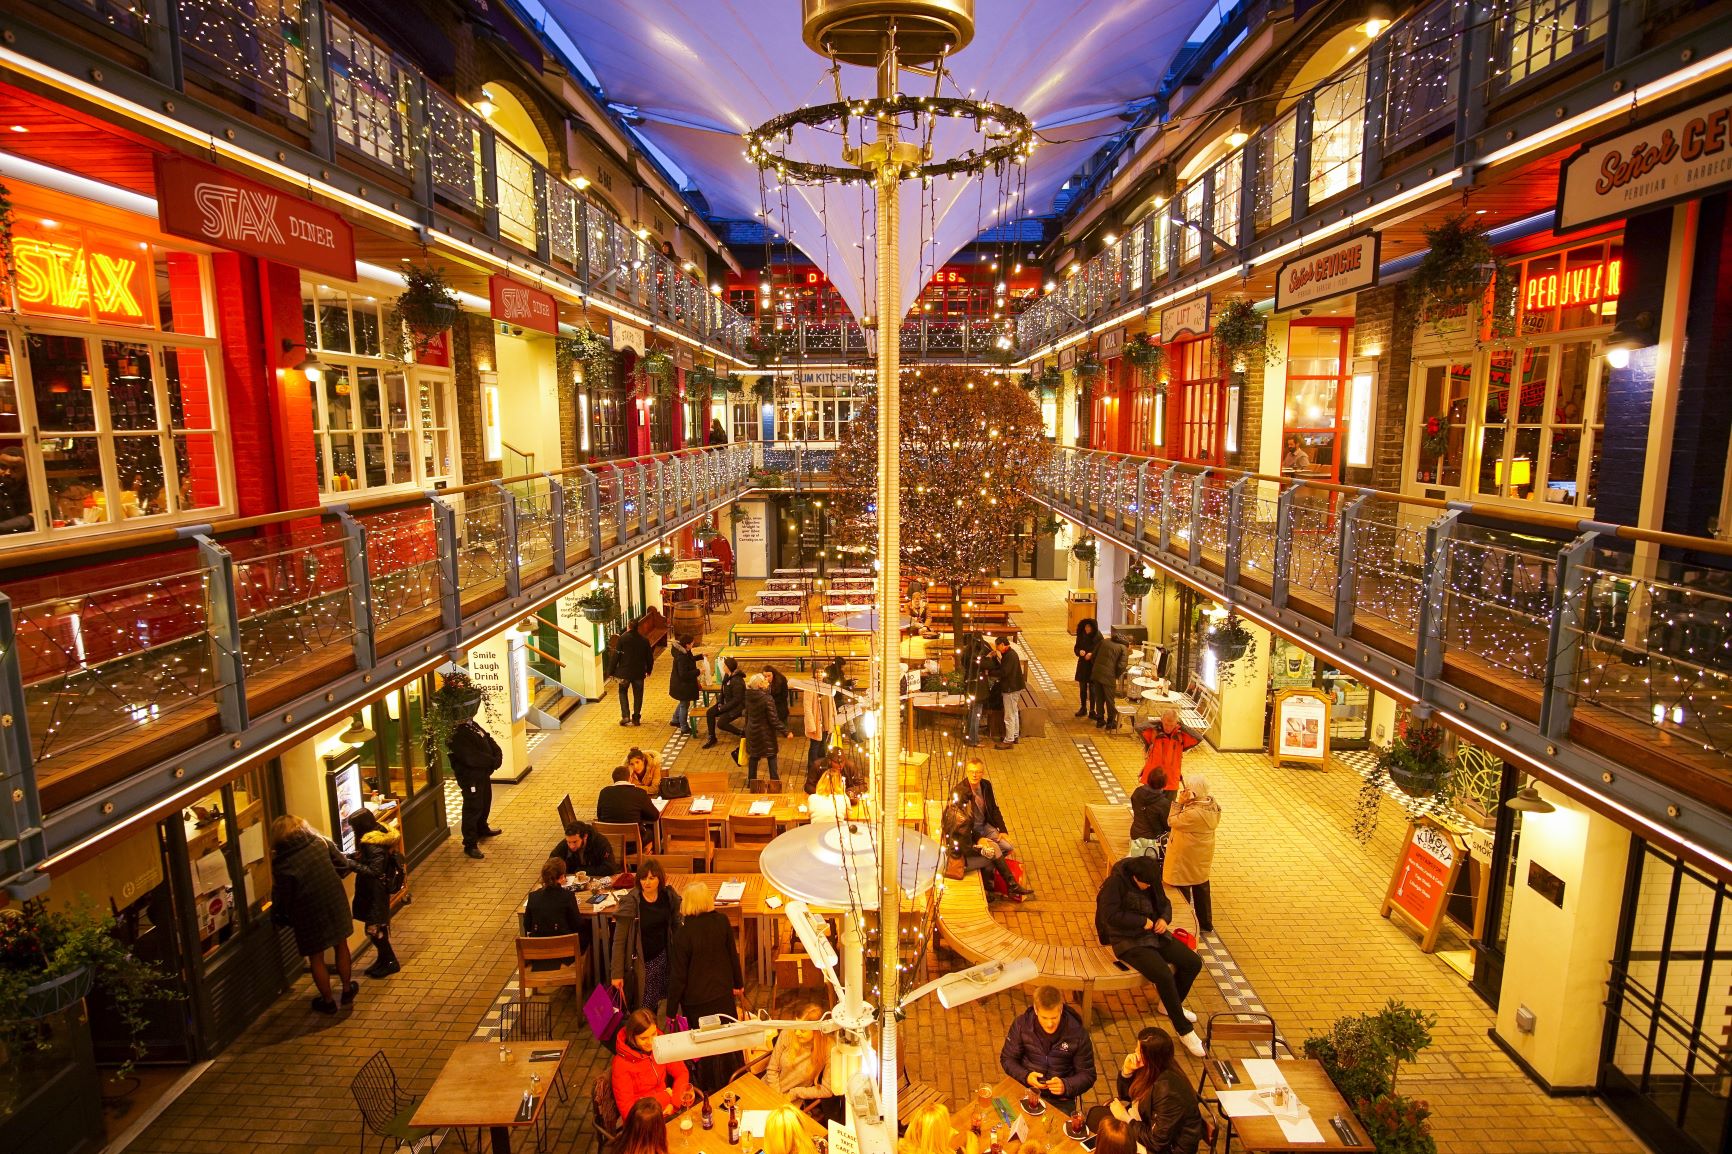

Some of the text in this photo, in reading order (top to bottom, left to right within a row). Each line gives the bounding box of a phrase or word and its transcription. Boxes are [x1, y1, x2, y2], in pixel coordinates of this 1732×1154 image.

[1596, 106, 1732, 196] Señor CE
[1624, 178, 1666, 201] PERUVIAN
[194, 182, 335, 248] STAX DINER
[1315, 244, 1362, 282] CEVICHE
[12, 237, 142, 317] STAX
[502, 288, 550, 318] STAX DINER
[1177, 307, 1190, 325] LIFT
[794, 373, 853, 385] RUM KITCHEN
[473, 651, 497, 659] Smile
[473, 662, 500, 671] Laugh
[474, 672, 499, 680] Drink
[476, 683, 504, 692] Gossip
[1417, 832, 1452, 860] KINGLY
[1473, 841, 1492, 857] SMOK
[1483, 839, 1494, 850] NO
[838, 1129, 857, 1143] PLEASE
[840, 1139, 854, 1149] TAKE
